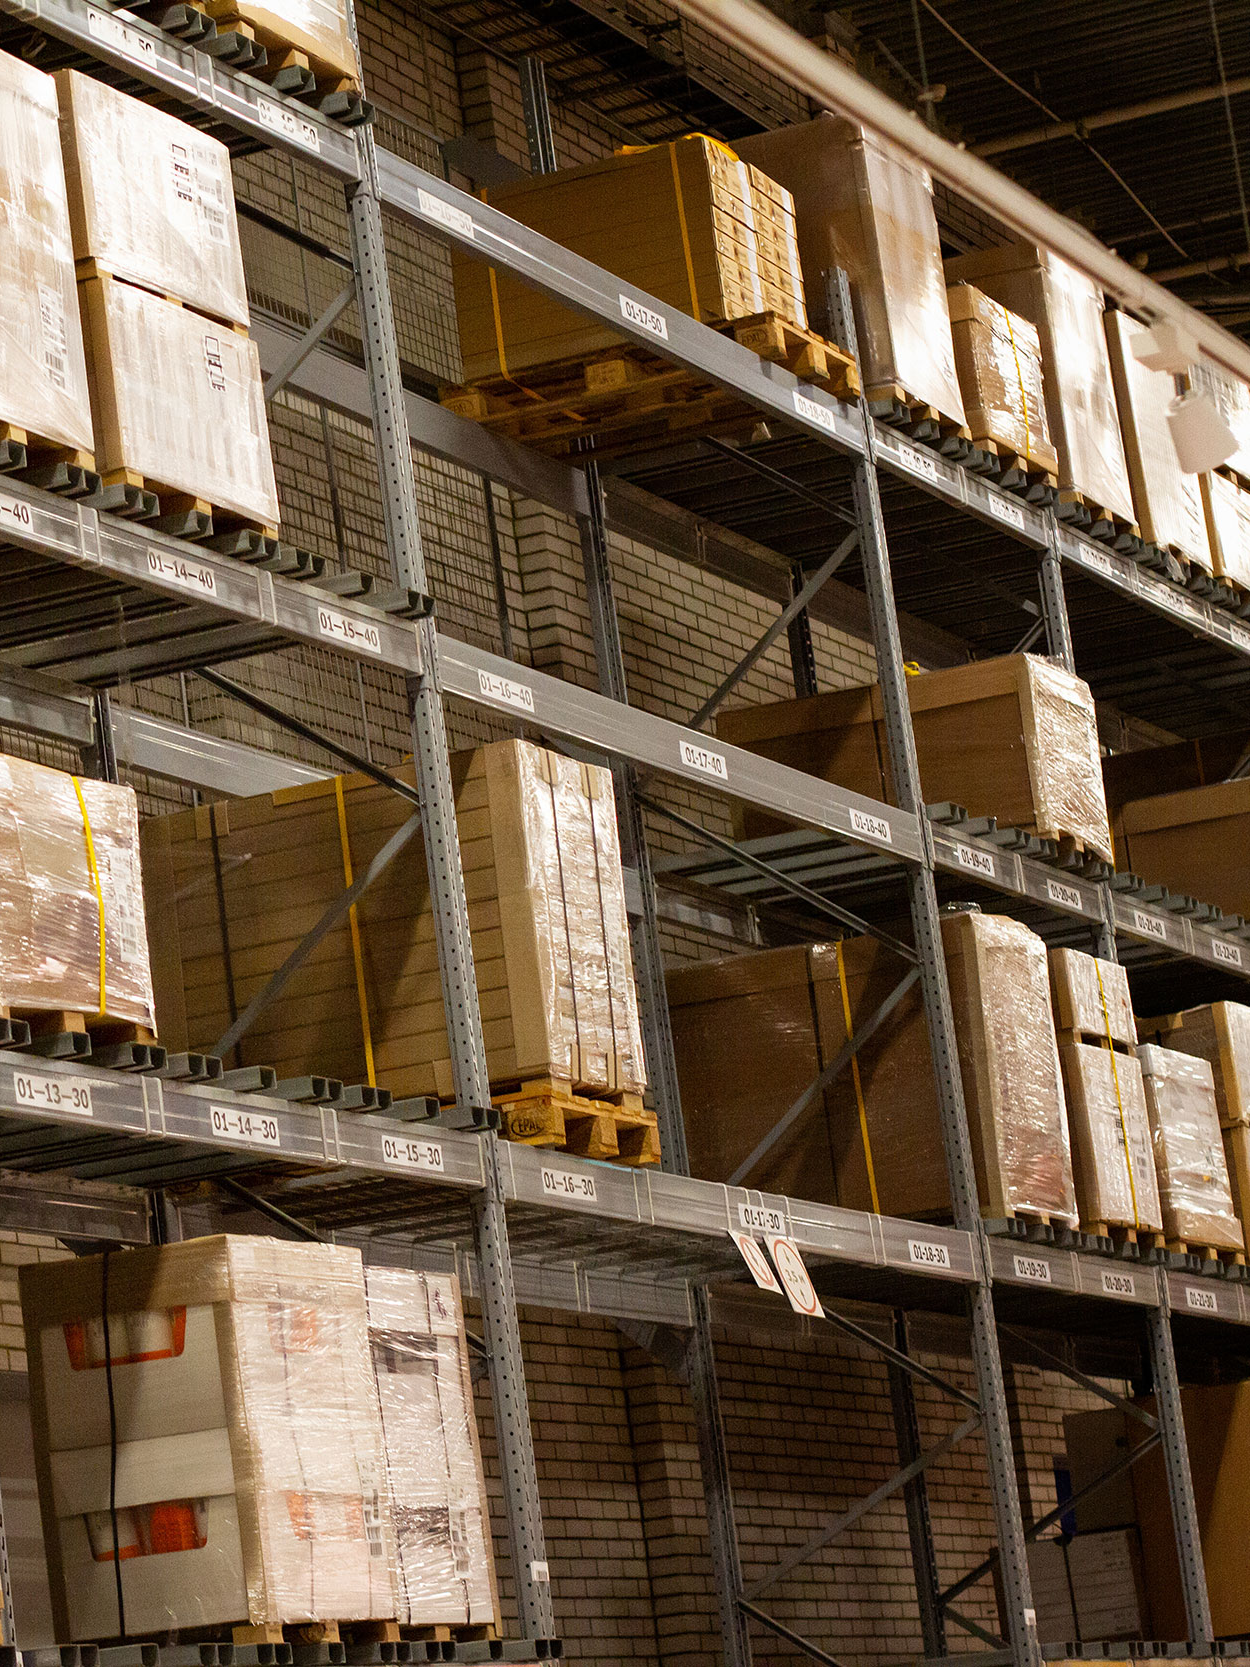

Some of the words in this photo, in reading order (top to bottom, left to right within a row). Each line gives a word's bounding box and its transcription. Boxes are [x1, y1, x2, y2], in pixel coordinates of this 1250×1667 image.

[626, 301, 662, 333] 01-17-50
[798, 398, 830, 426] 01-18-50
[149, 553, 214, 590] 01-14-40
[320, 612, 378, 646] 01-15-40
[479, 675, 532, 706] 01-16-40
[686, 747, 722, 773] 01-17-40
[854, 814, 887, 837] 01-18-40
[962, 849, 991, 873] 01-19-40
[1050, 884, 1079, 907] 01-20-40
[1138, 915, 1162, 936] 01-21-40
[1215, 943, 1239, 962] 01-22-40
[17, 1078, 89, 1111] 01-13-30
[213, 1111, 276, 1141] 01-14-30
[384, 1140, 440, 1167] 01-15-30
[544, 1172, 593, 1196] 01-16-30
[914, 1245, 945, 1263] 01-18-30
[1018, 1260, 1047, 1278] 01-19-30
[1105, 1276, 1132, 1293] 01-20-30
[1190, 1292, 1214, 1309] 01-21-30
